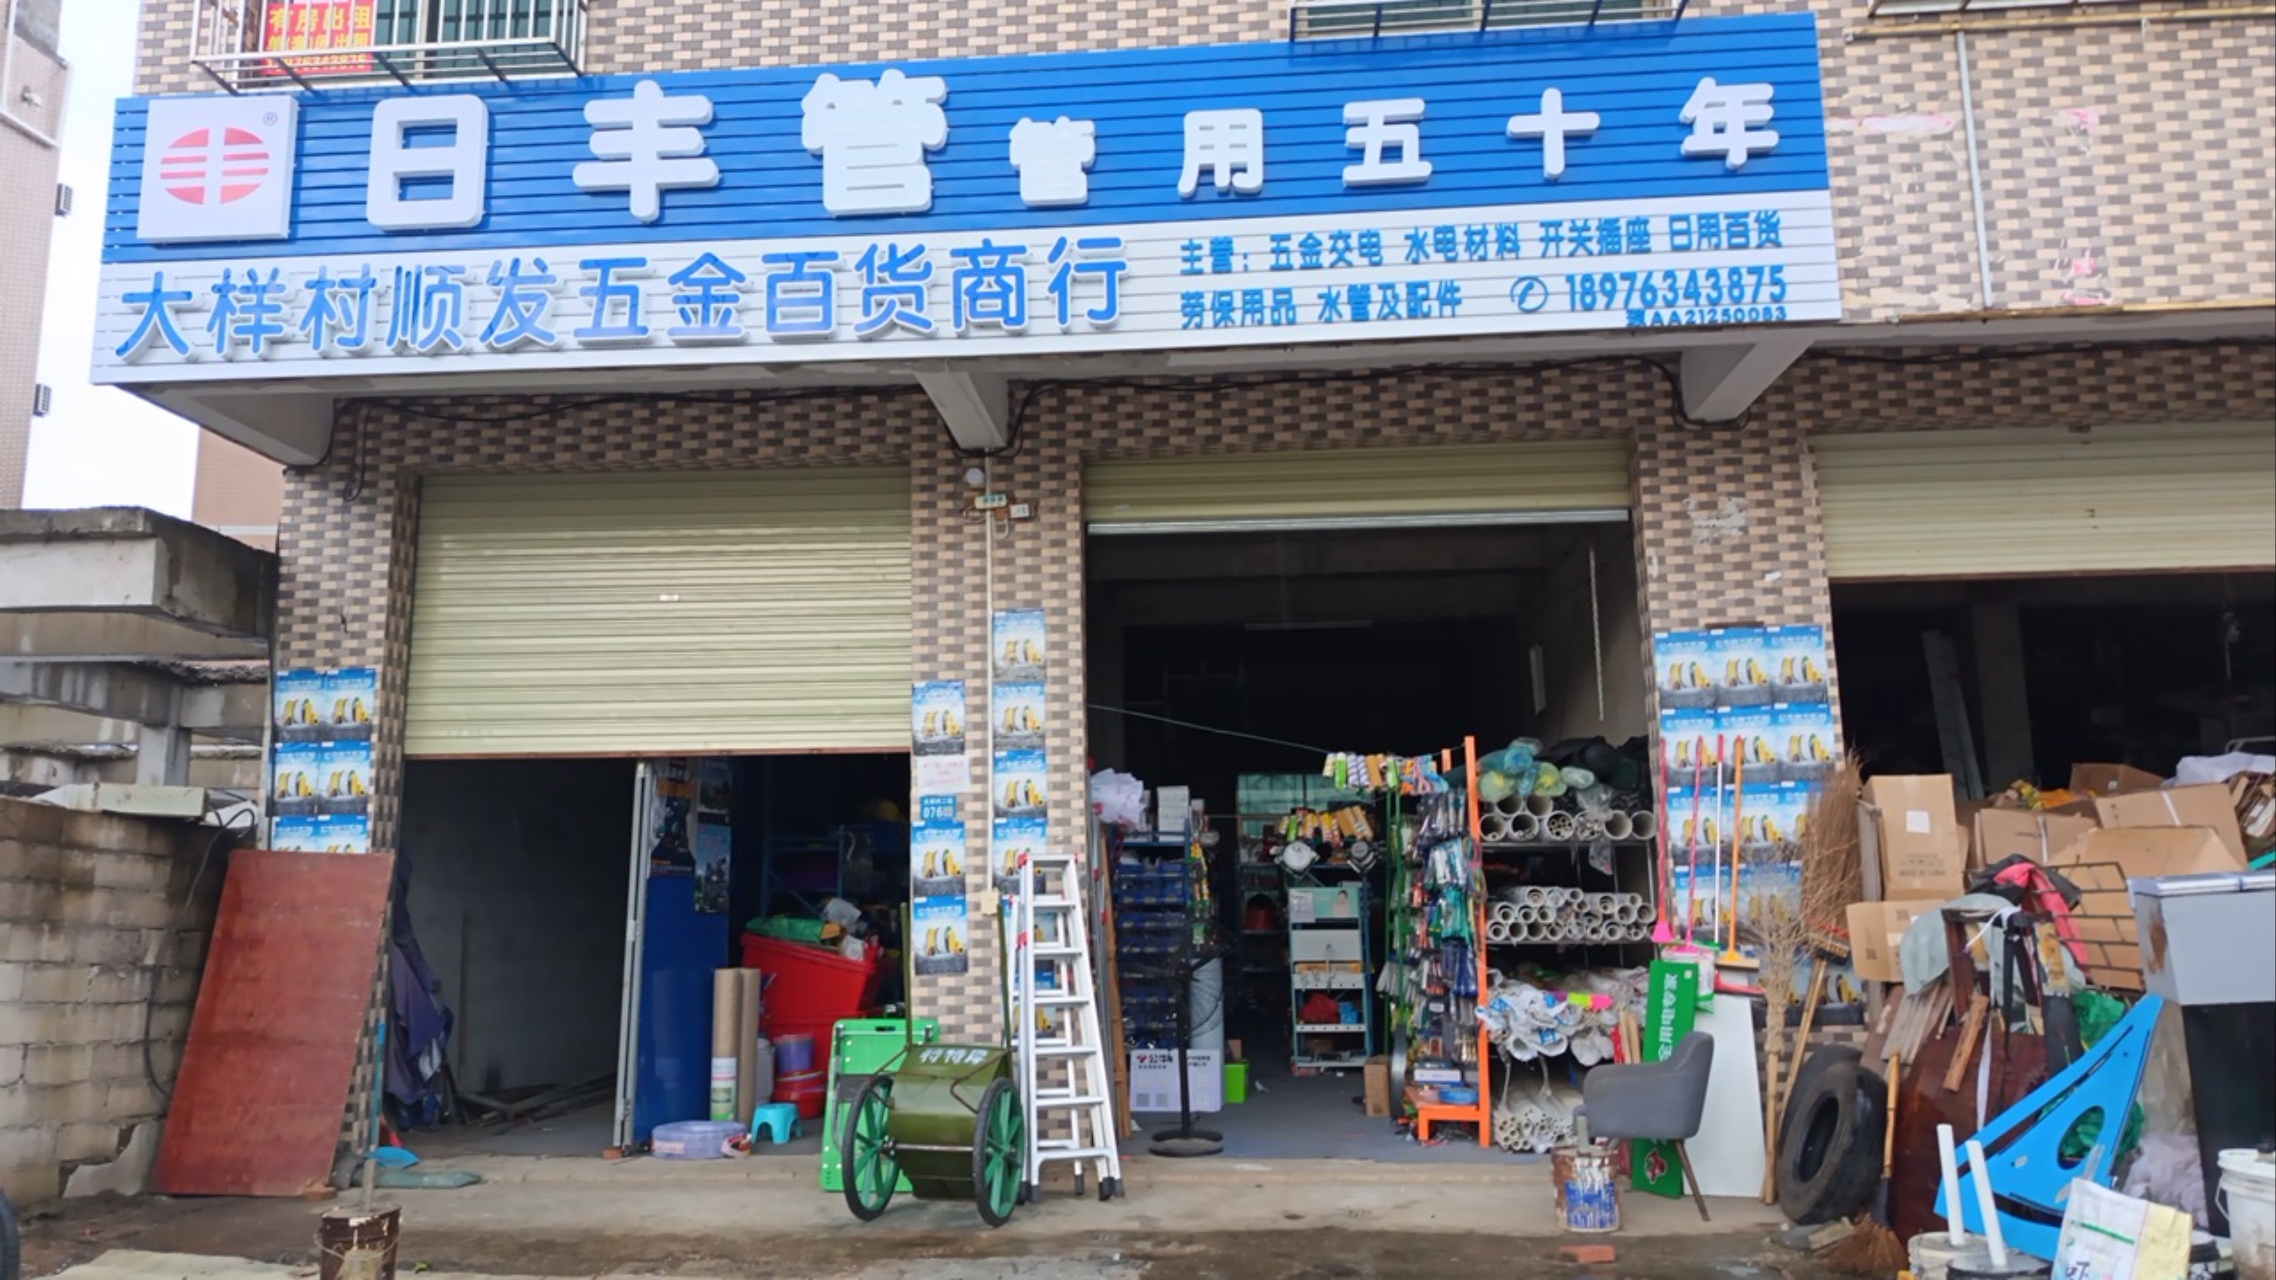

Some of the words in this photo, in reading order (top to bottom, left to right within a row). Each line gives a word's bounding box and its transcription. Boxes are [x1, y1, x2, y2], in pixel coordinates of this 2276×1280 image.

[366, 69, 949, 232] 日丰管
[1269, 229, 1383, 271] 五金交电
[1405, 222, 1521, 264] 水电材料
[1539, 216, 1652, 257] 开关插座
[1668, 210, 1783, 252] 日用百货
[115, 235, 1126, 360] 大样村顺发五金百货商行
[1180, 286, 1297, 330] 劳保用品
[1317, 279, 1463, 324] 水管及配件
[1566, 264, 1787, 312] 18976343875
